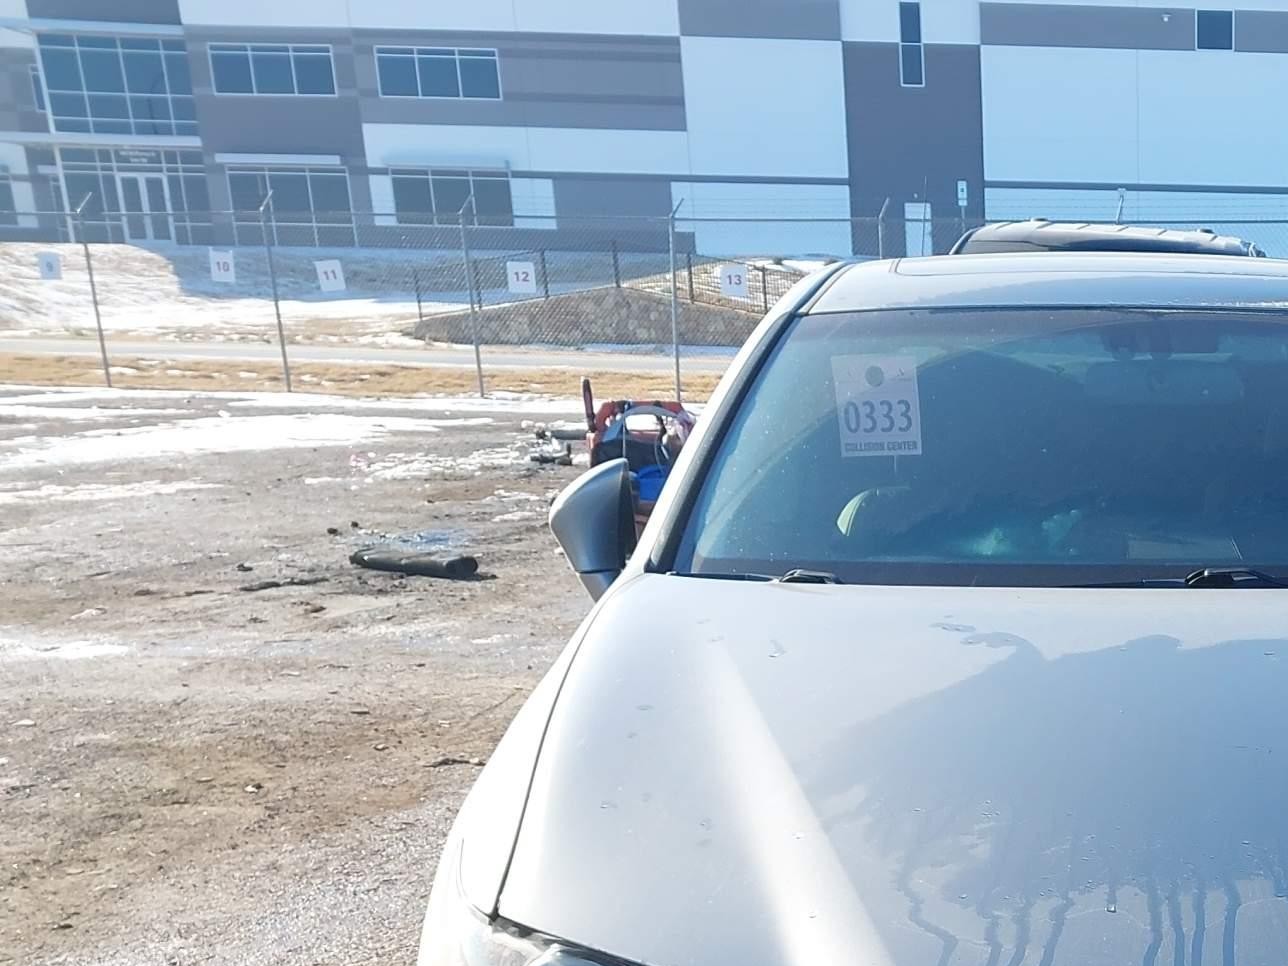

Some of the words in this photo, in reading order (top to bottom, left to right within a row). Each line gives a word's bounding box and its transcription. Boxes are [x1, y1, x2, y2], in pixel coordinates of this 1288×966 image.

[216, 261, 230, 273] 10
[323, 269, 338, 281] 11
[514, 271, 530, 283] 12
[727, 274, 743, 286] 13
[844, 399, 913, 434] 0333
